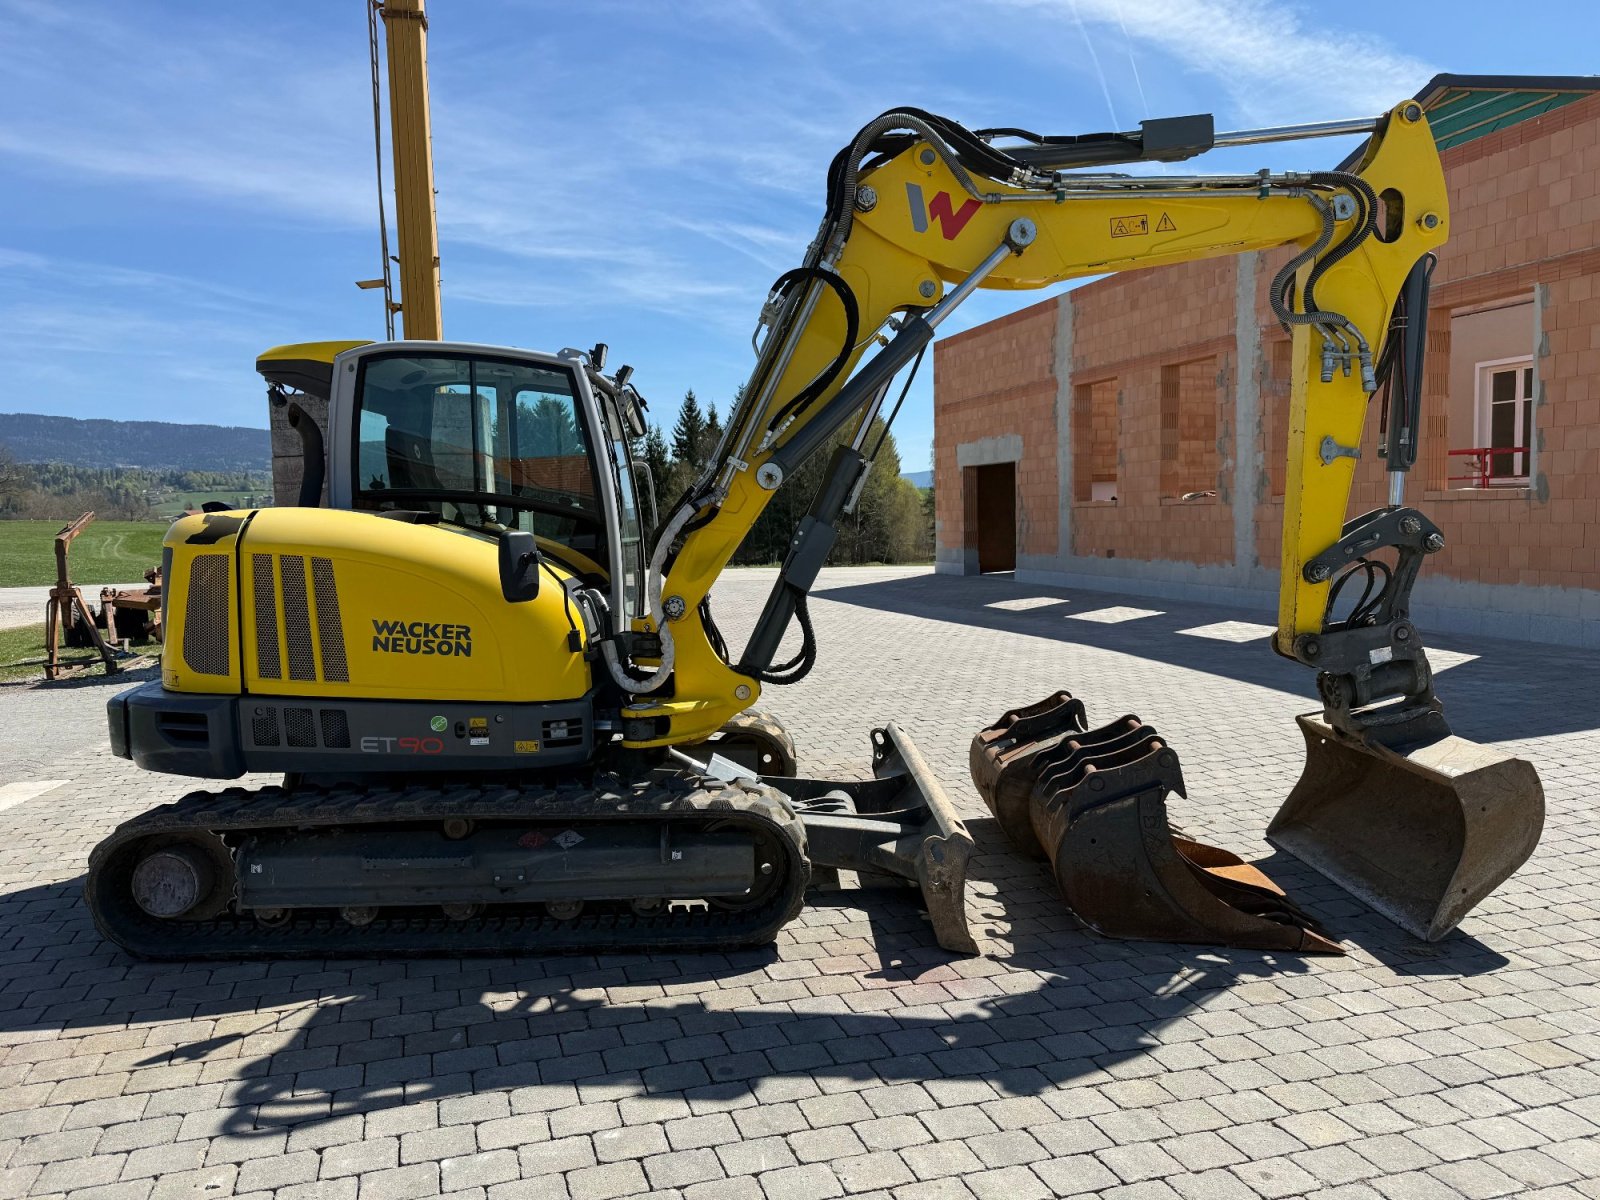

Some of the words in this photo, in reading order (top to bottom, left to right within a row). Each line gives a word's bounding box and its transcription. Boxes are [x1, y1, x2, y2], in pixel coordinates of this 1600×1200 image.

[372, 619, 472, 641] WACKER
[372, 636, 472, 657] NEUSON
[360, 736, 445, 753] ET90
